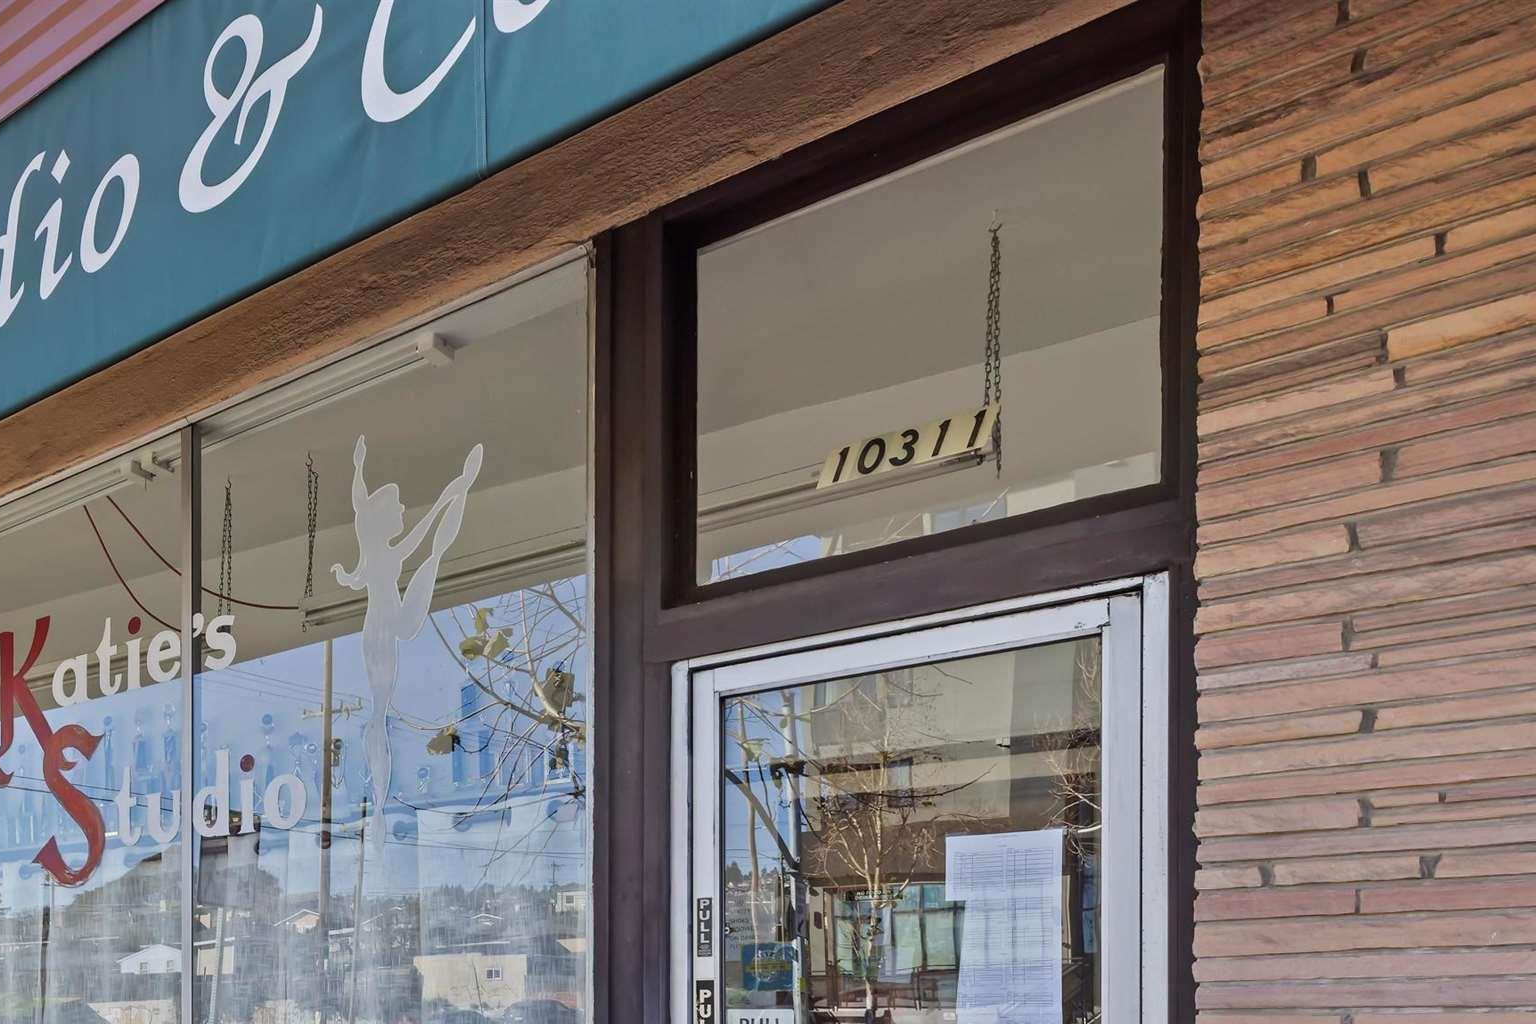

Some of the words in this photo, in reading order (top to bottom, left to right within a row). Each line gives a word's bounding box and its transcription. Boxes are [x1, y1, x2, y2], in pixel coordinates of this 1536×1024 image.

[179, 3, 323, 214] &
[361, 0, 551, 123] C
[832, 409, 987, 483] 10311
[31, 724, 308, 888] Studio
[698, 899, 711, 943] PULL
